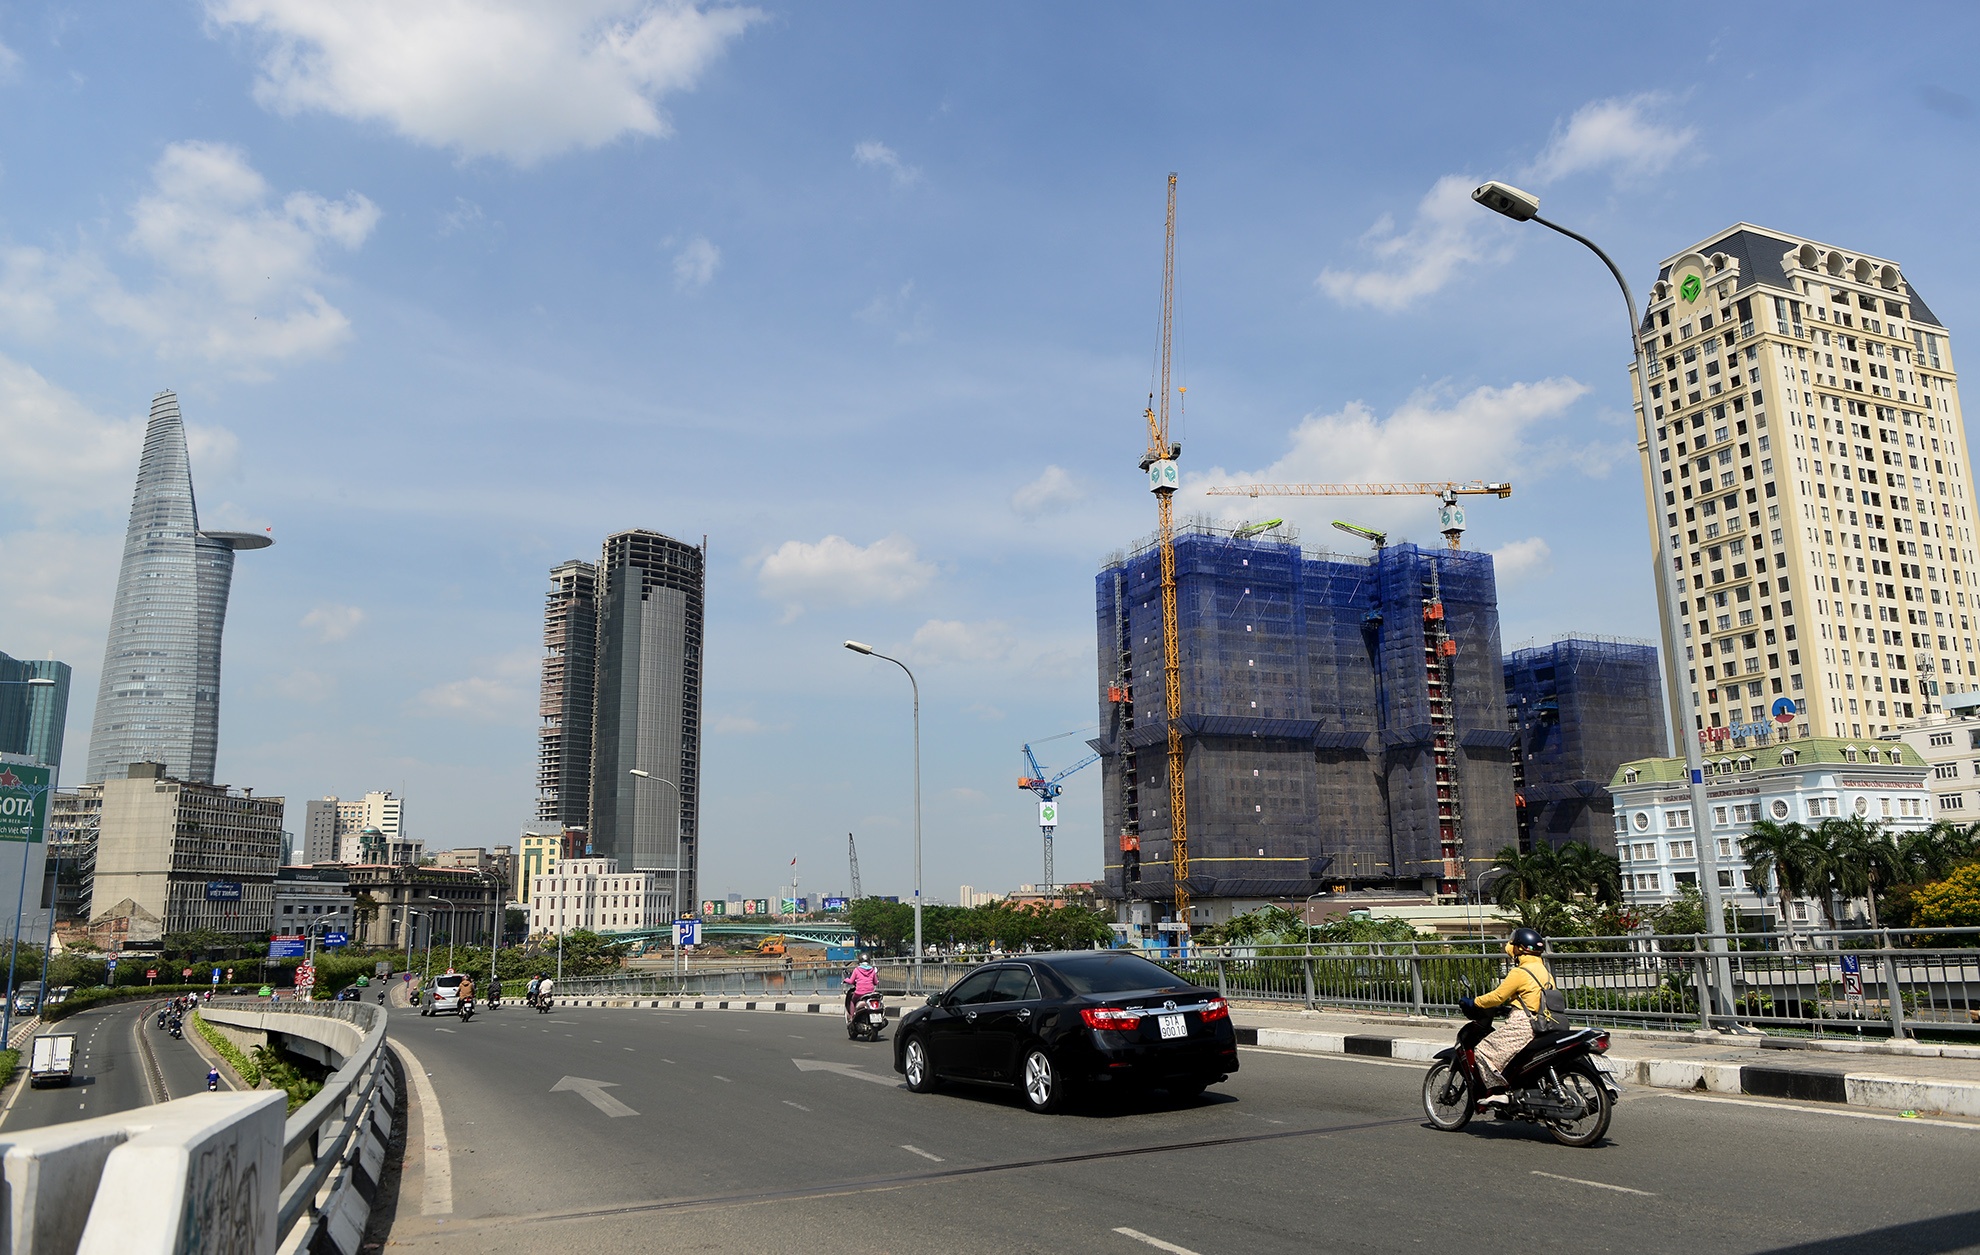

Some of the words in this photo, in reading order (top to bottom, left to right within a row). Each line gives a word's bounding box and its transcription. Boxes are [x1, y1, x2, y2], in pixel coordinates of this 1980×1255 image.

[1680, 716, 1774, 744] etinBank
[0, 796, 35, 817] OTA
[1164, 1015, 1180, 1026] 51A
